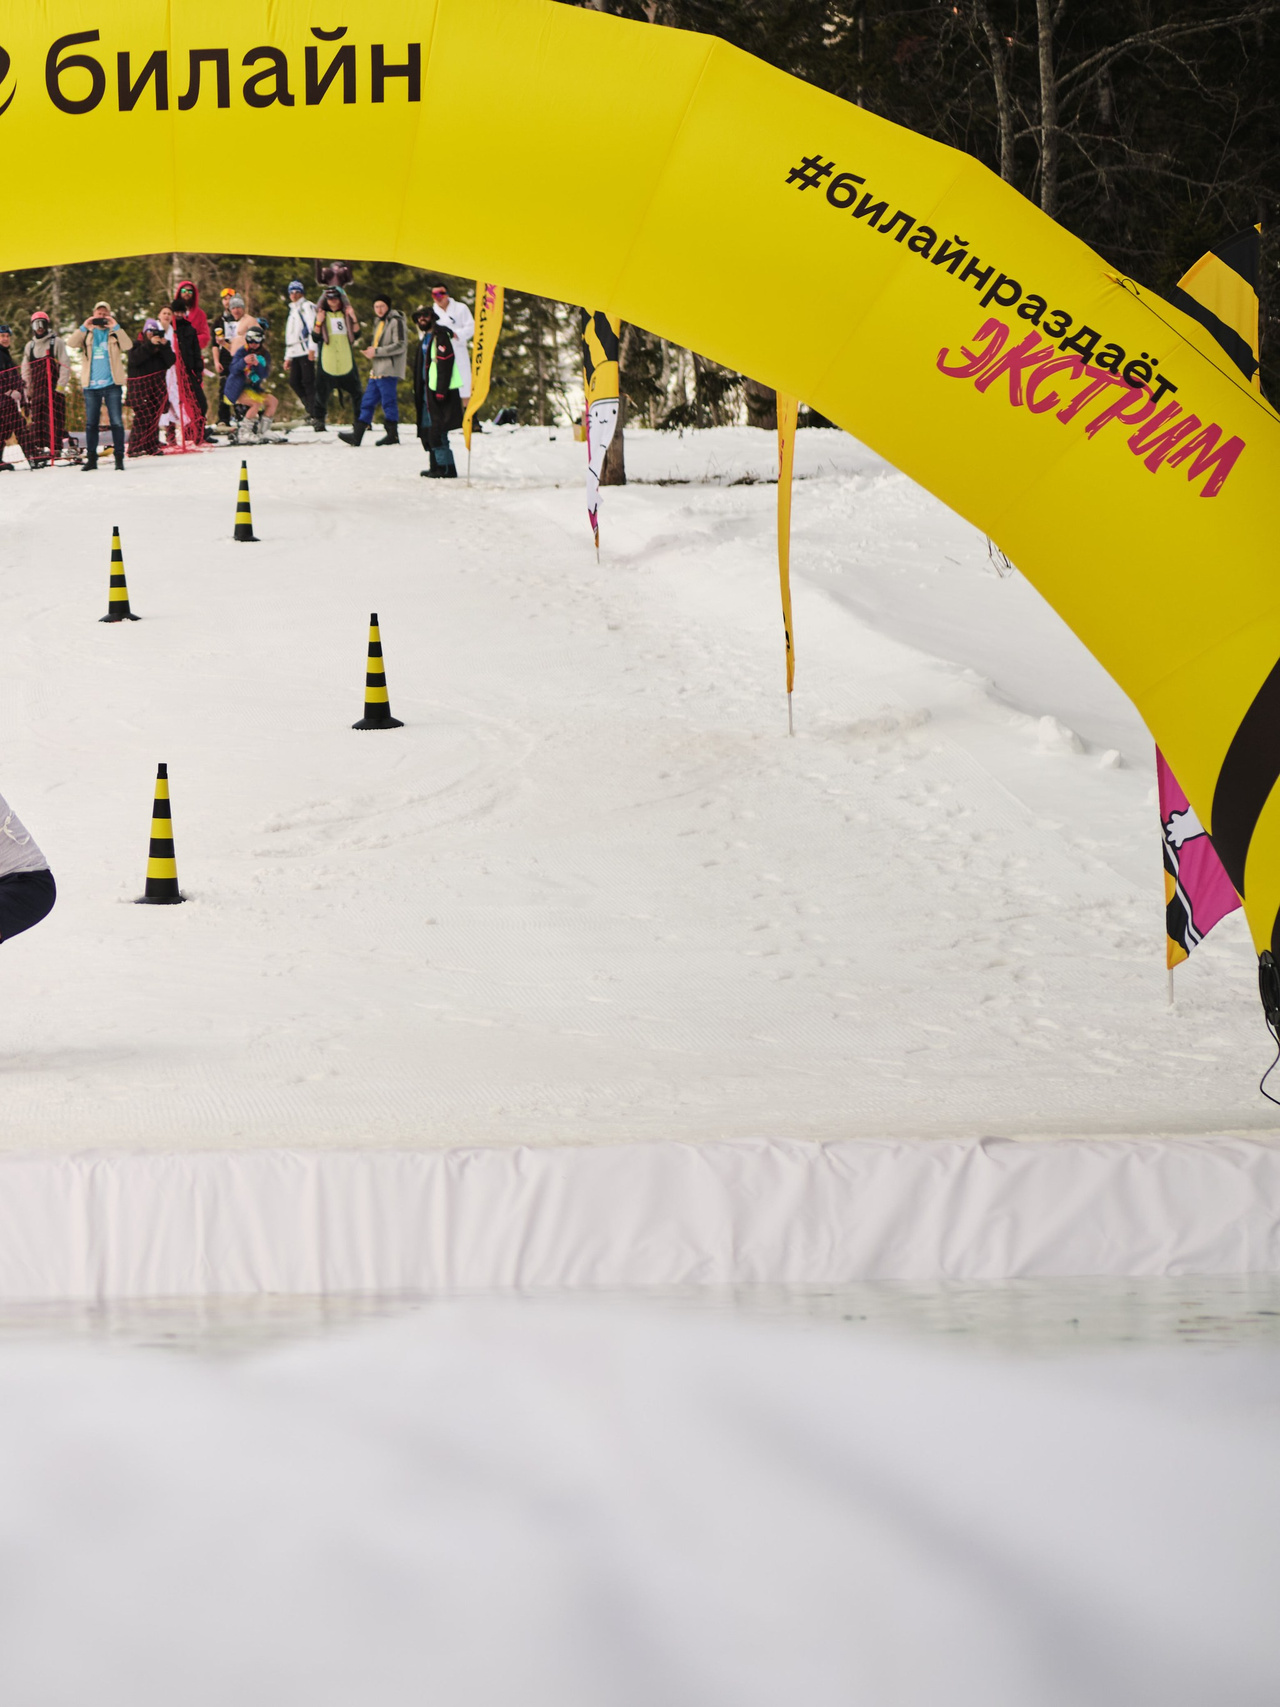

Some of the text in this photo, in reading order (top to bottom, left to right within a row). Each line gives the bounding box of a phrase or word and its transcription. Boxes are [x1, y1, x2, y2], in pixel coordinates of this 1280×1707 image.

[45, 26, 421, 115] билайн
[337, 321, 344, 331] 8
[785, 153, 1179, 404] #билайнраздаёт
[936, 317, 1246, 498] ЭКСТРИМ
